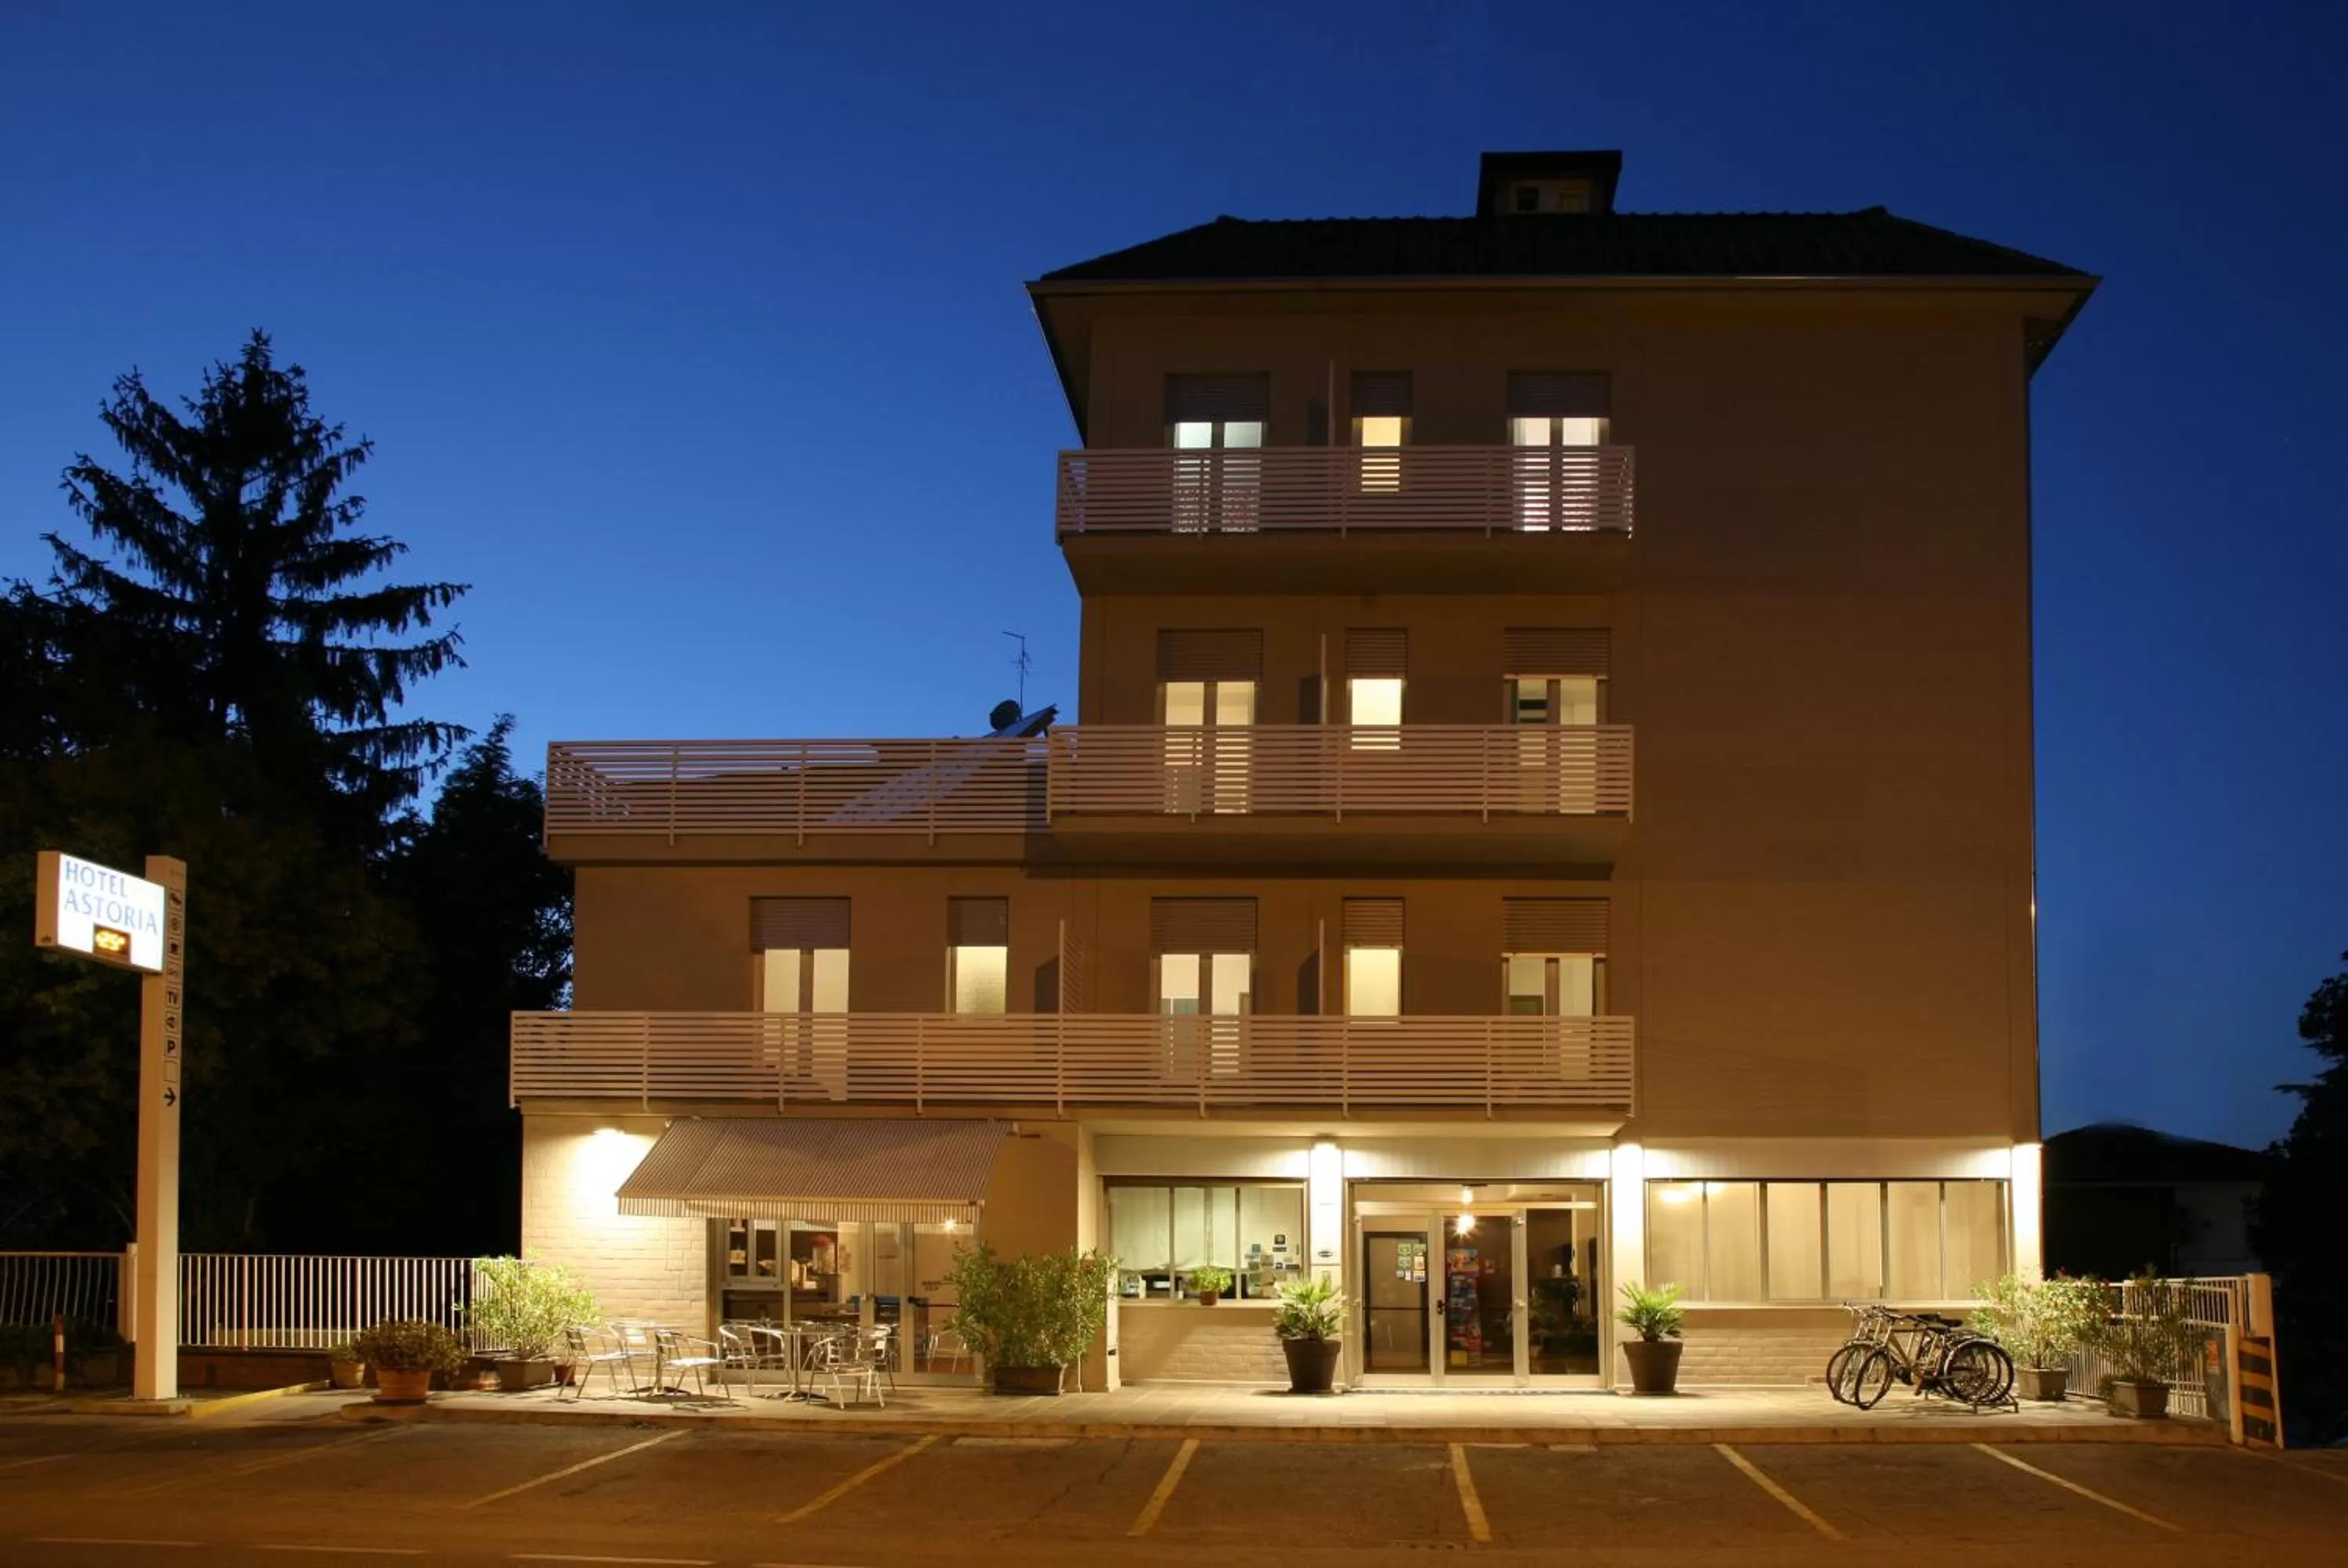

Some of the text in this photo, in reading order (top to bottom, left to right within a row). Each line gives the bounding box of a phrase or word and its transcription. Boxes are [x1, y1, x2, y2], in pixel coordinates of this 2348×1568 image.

[66, 861, 128, 898] HOTEL
[64, 888, 158, 936] ASTORIA
[167, 1039, 176, 1054] P
